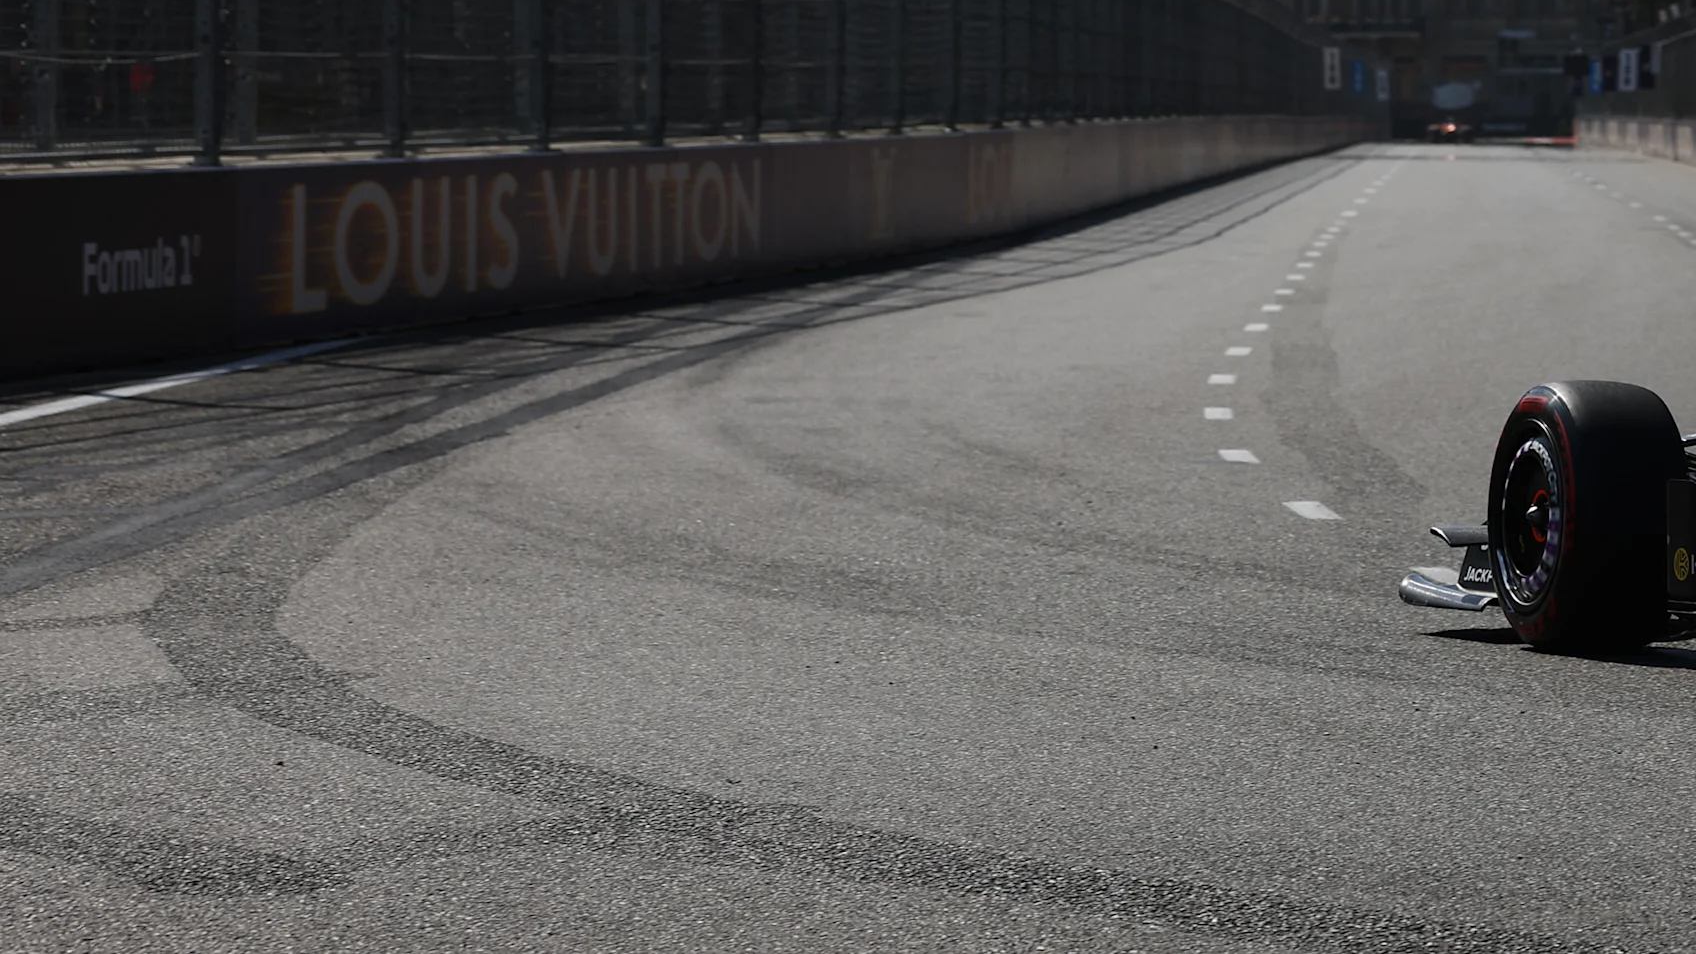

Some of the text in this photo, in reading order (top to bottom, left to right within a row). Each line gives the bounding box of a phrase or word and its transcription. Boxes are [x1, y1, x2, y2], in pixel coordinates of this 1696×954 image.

[288, 158, 762, 313] LOUIS VUITTON
[82, 236, 176, 296] Formula
[1463, 565, 1494, 583] JACKP
